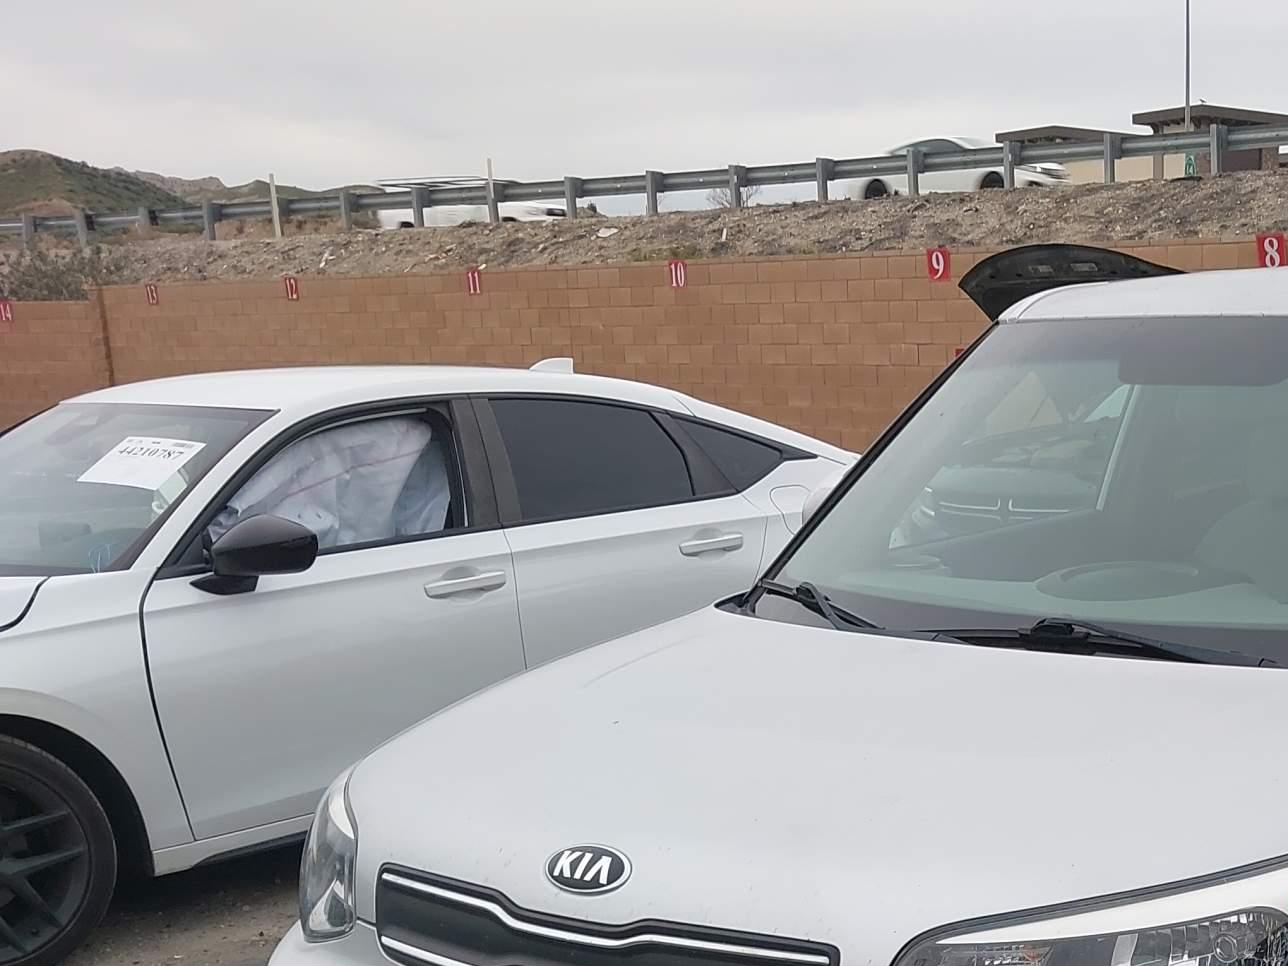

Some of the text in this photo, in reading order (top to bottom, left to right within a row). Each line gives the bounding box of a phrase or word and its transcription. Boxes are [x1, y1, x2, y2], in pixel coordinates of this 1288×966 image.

[1264, 237, 1280, 268] 8
[669, 262, 685, 288] 10
[931, 251, 945, 280] 9
[285, 278, 297, 300] 12
[468, 271, 481, 294] 11
[147, 285, 158, 304] 13
[0, 302, 12, 321] 14
[119, 445, 185, 461] 44210787
[552, 849, 613, 885] KIA
